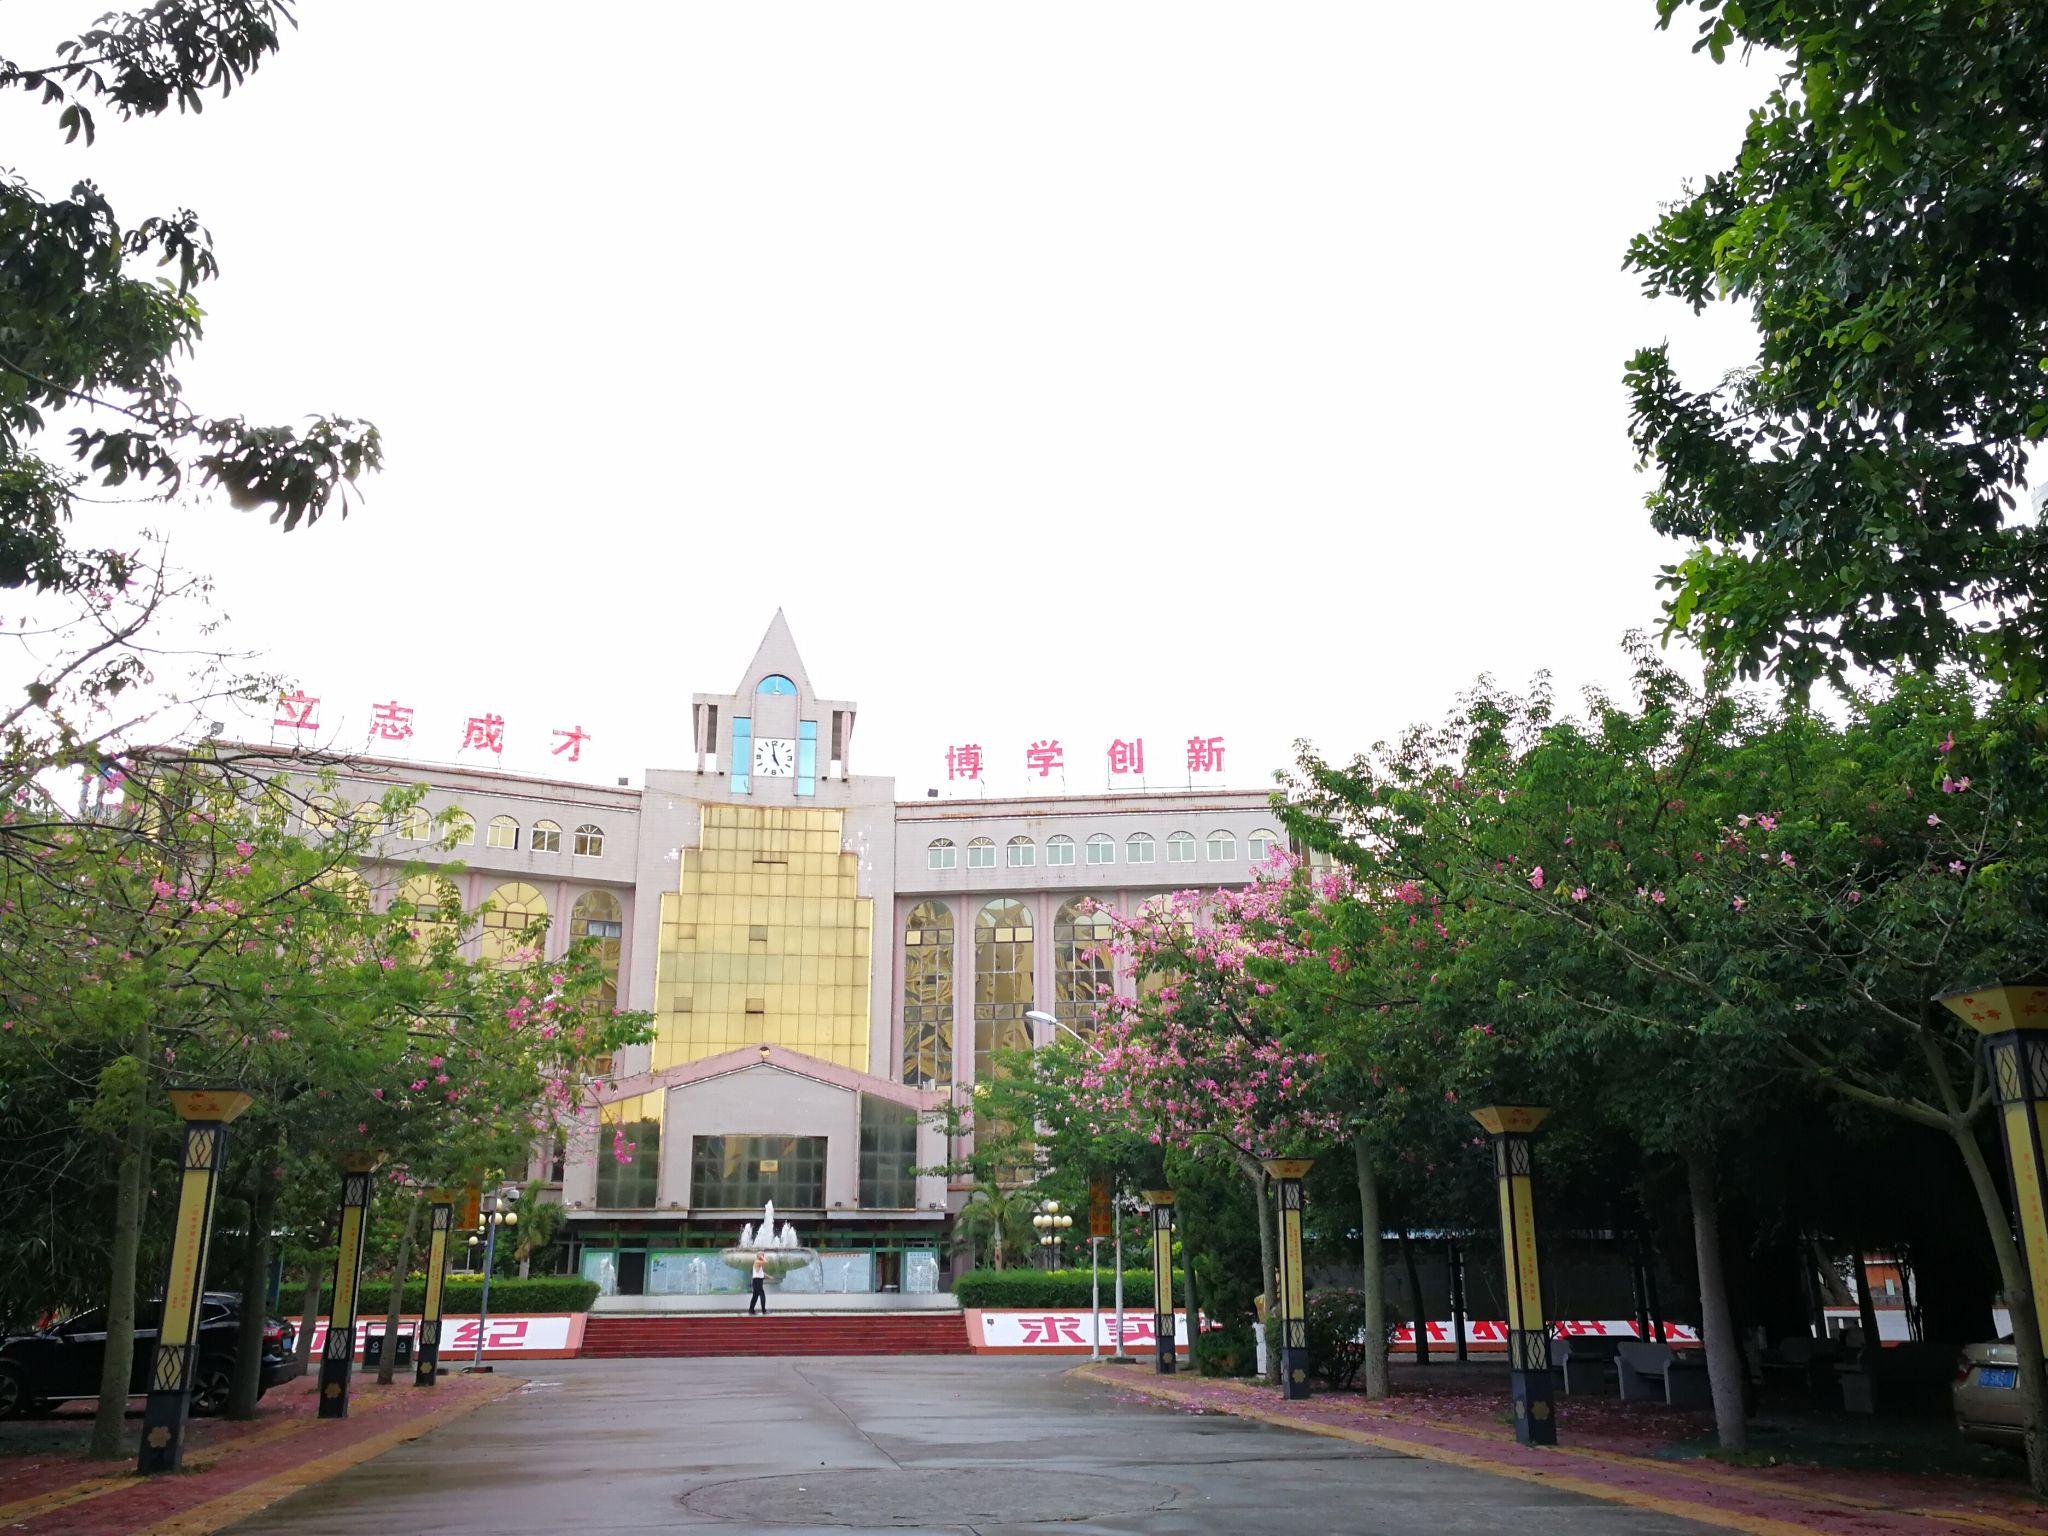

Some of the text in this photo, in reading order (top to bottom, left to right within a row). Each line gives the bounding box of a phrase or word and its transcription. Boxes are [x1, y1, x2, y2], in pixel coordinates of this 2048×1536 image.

[273, 689, 592, 763] 立志成才
[944, 735, 1226, 781] 博学创新
